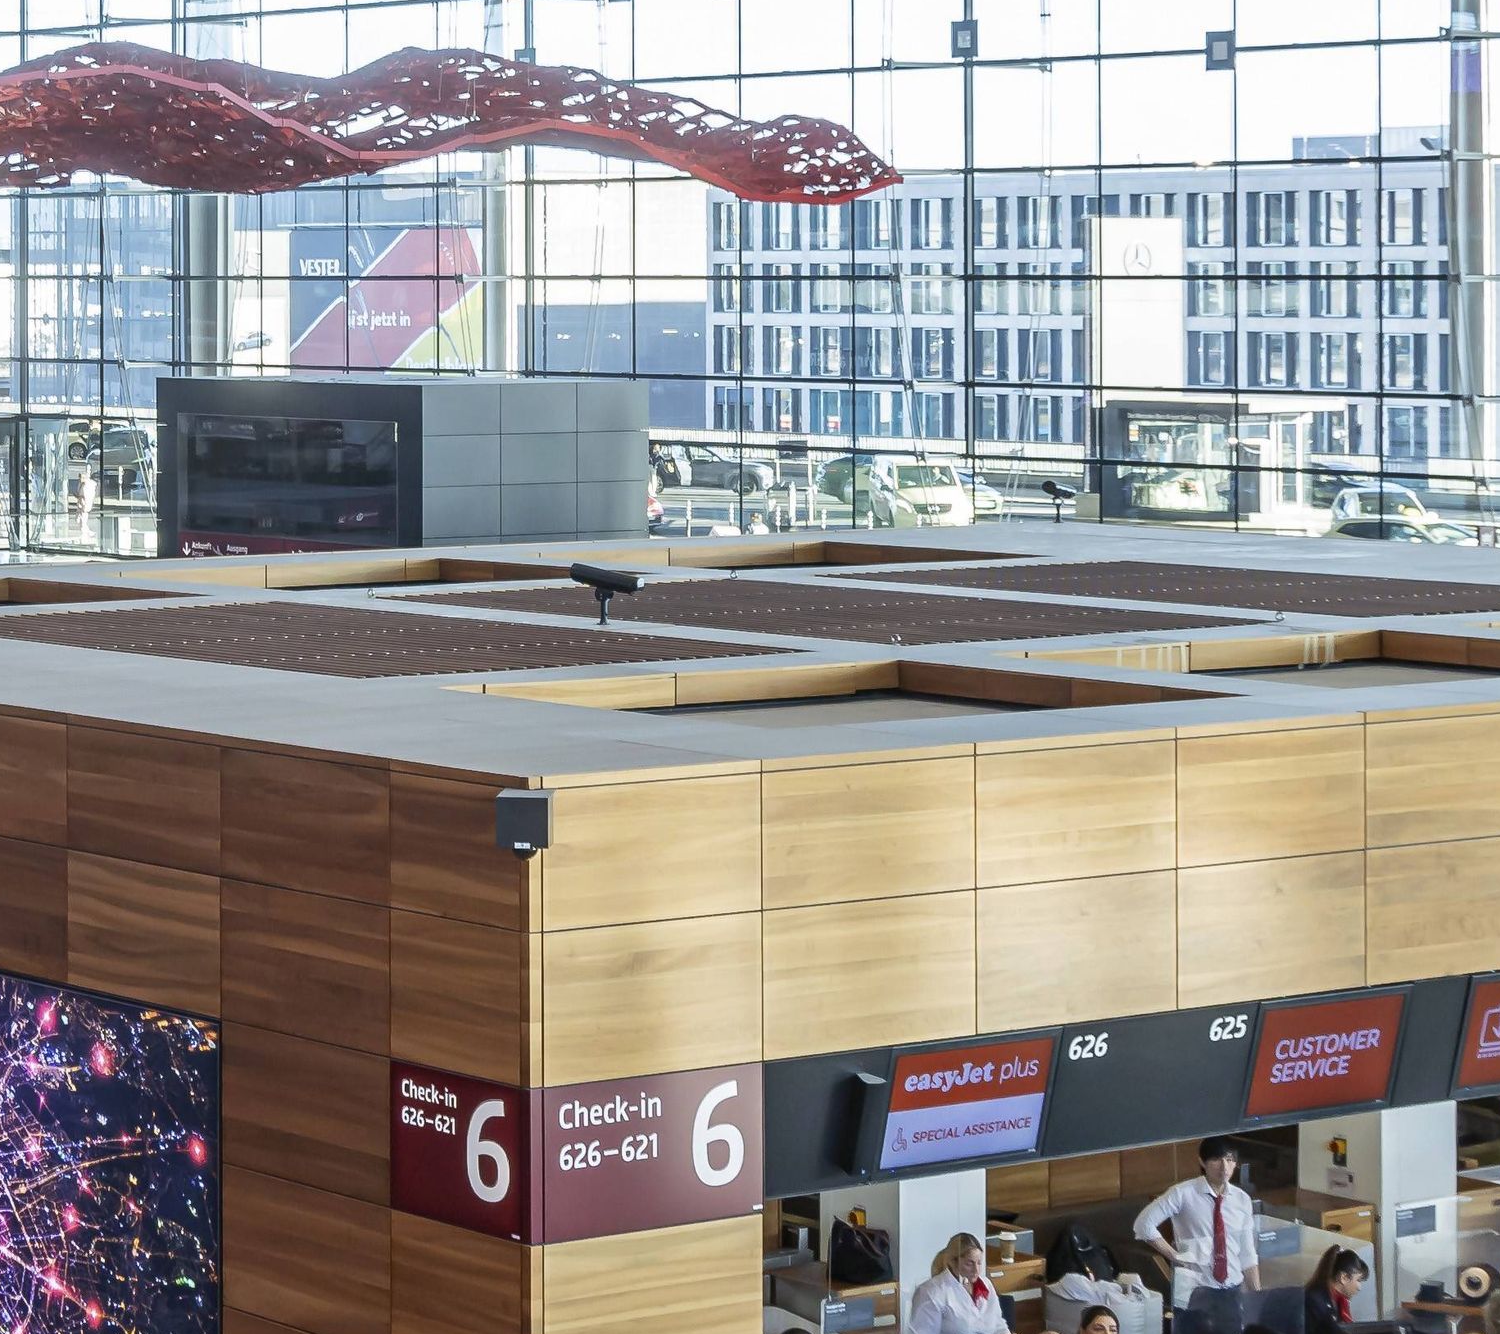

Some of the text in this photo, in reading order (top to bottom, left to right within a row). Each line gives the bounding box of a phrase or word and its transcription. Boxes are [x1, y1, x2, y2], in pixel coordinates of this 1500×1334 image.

[400, 310, 411, 327] in
[1208, 1014, 1249, 1042] 625
[1067, 1032, 1109, 1061] 626
[1274, 1027, 1381, 1061] CUSTOMER
[903, 1055, 1040, 1093] easyJet plus
[1269, 1054, 1352, 1084] SERVICE
[401, 1078, 457, 1109] Check-in
[558, 1090, 663, 1130] Check-in
[691, 1079, 745, 1187] 6
[911, 1117, 1032, 1144] SPECIAL ASSISTANCE
[466, 1098, 511, 1203] 6
